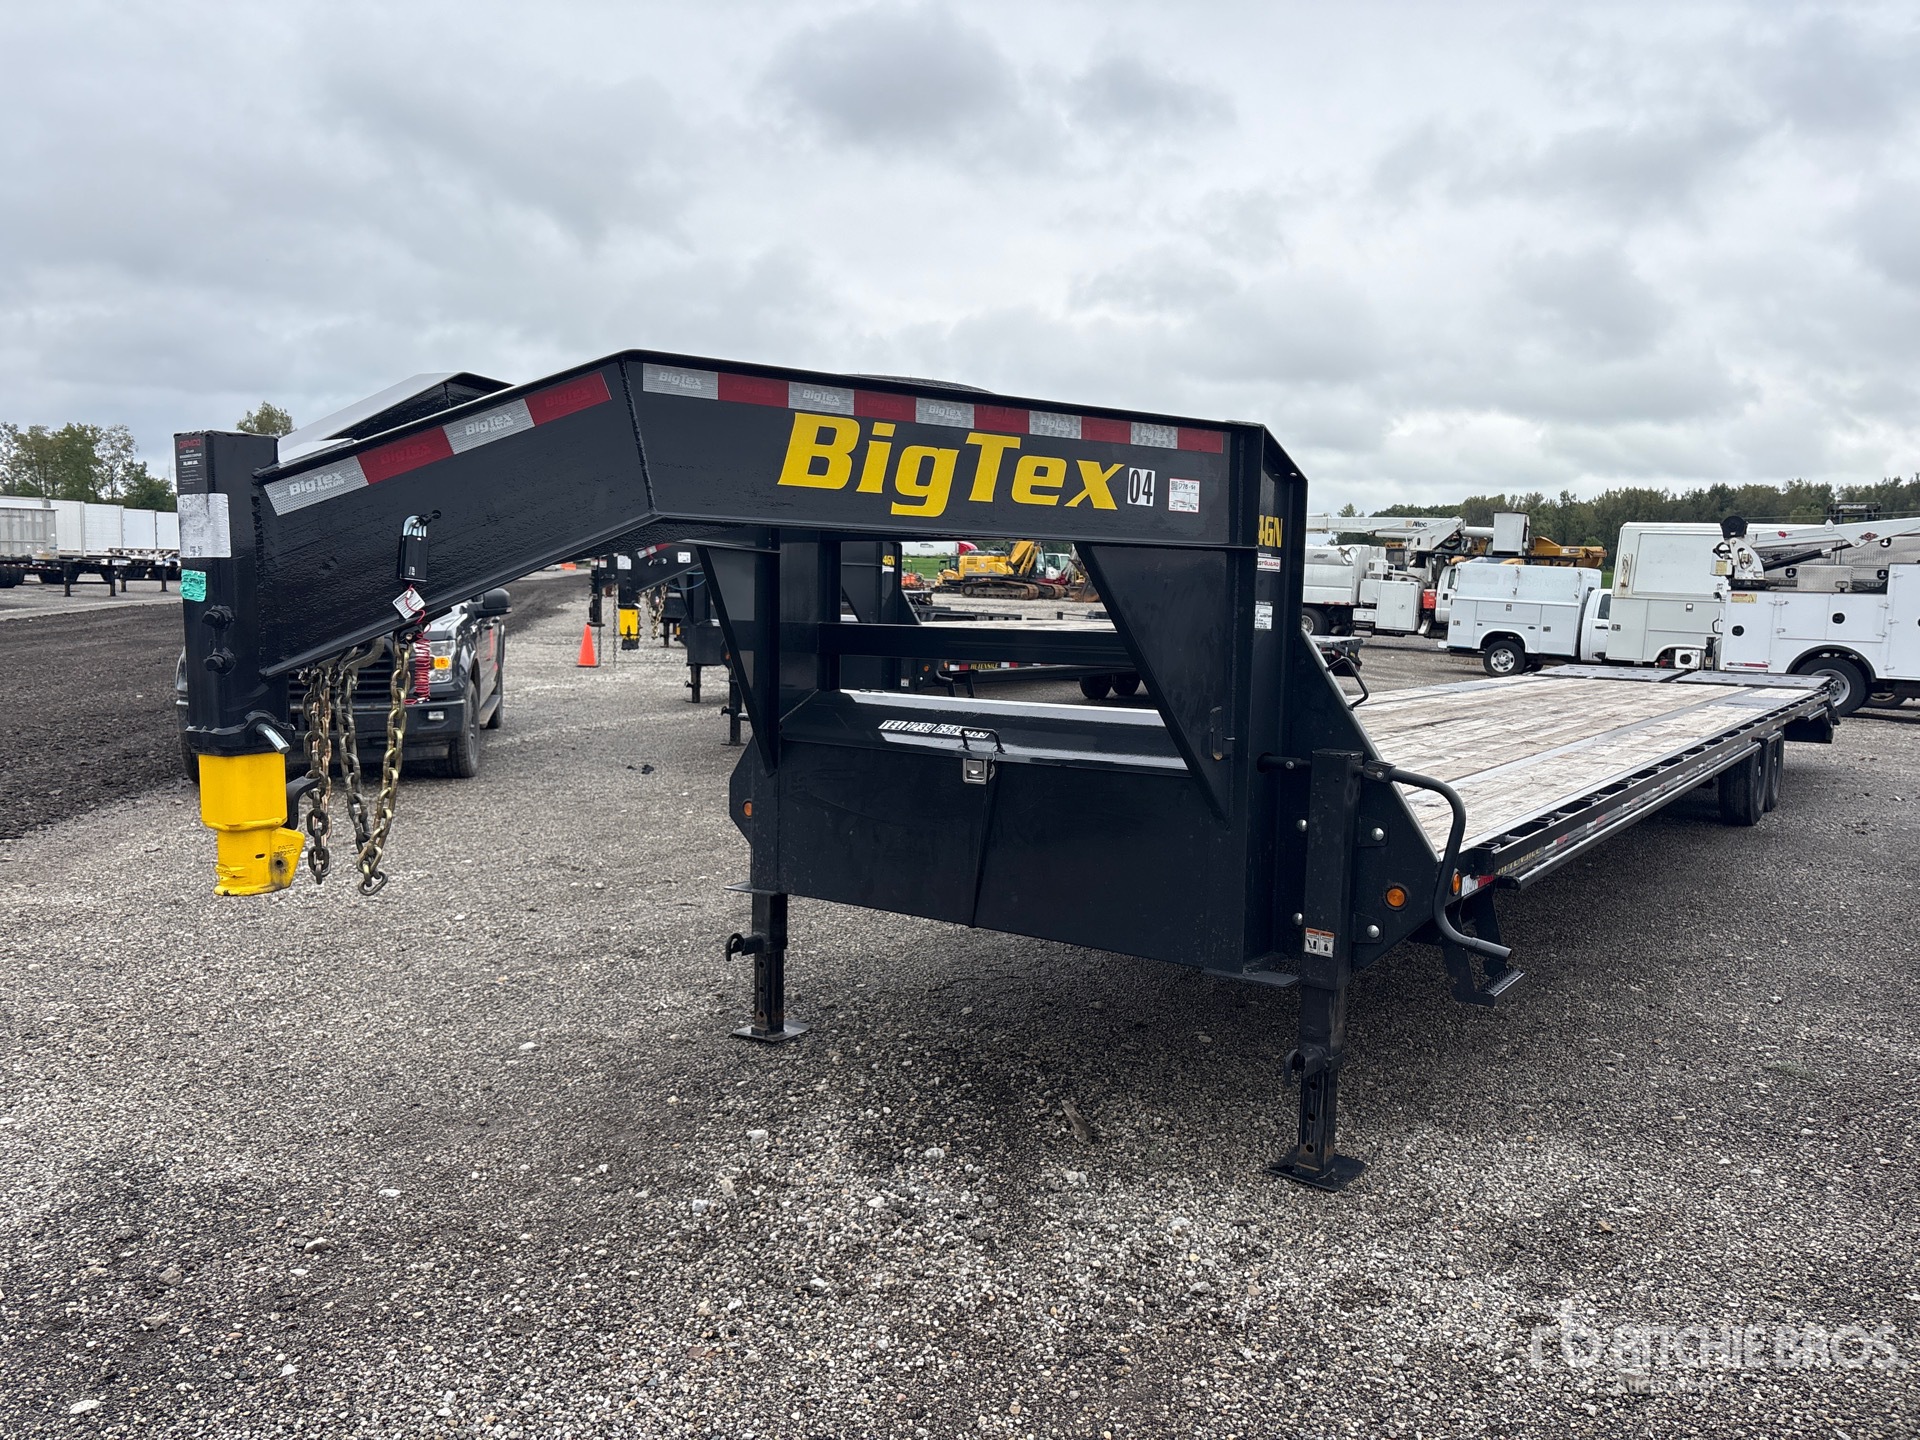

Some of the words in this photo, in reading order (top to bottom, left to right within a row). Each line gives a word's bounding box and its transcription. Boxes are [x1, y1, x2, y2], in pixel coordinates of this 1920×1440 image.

[658, 372, 703, 385] BigTex
[802, 389, 841, 402] BigTex
[928, 405, 963, 417] BigTex
[465, 413, 514, 436] BigTex
[1040, 417, 1072, 429] BigTex
[777, 412, 1125, 518] BigTex
[288, 471, 344, 496] BigTex
[1129, 469, 1153, 505] 04
[1411, 520, 1428, 529] Altec
